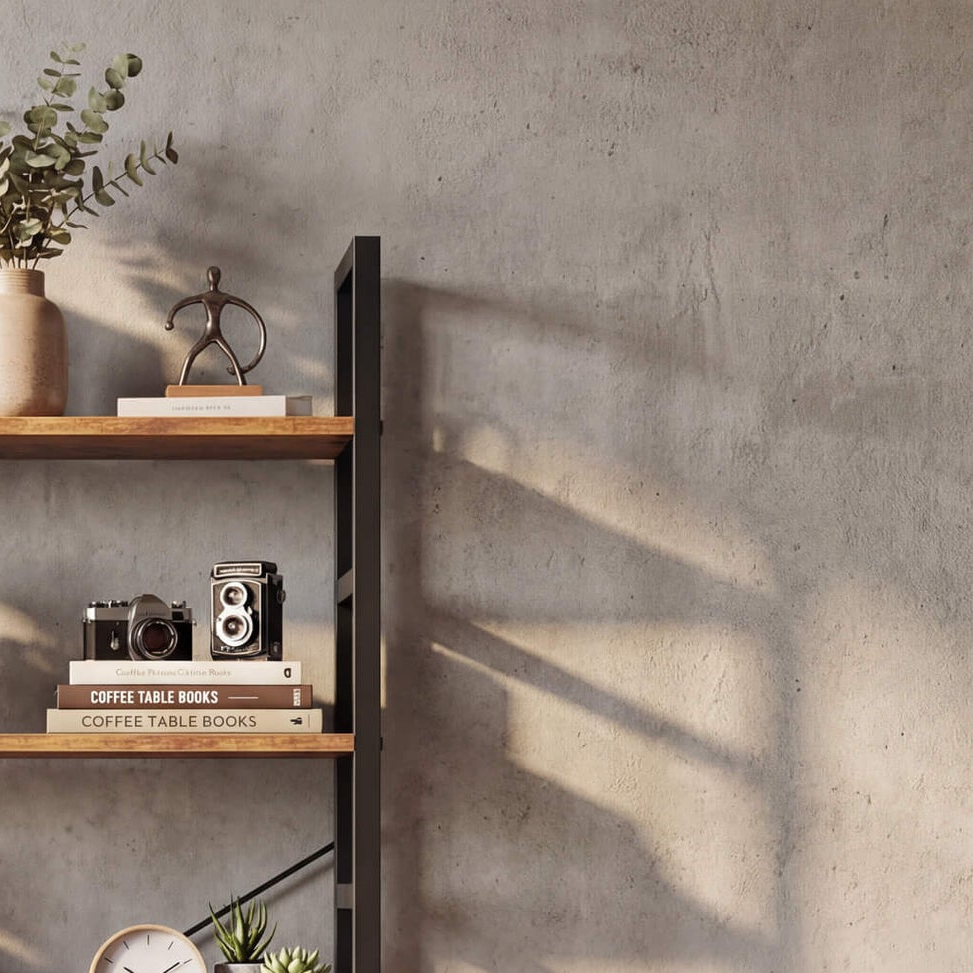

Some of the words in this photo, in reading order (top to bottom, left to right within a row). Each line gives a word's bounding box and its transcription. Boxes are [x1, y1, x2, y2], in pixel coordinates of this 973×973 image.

[90, 690, 135, 704] COFFEE
[138, 690, 175, 704] TABLE
[178, 690, 219, 704] BOOKS
[81, 715, 143, 728] COFFEE
[148, 715, 198, 728] TABLE
[202, 715, 258, 728] BOOKS
